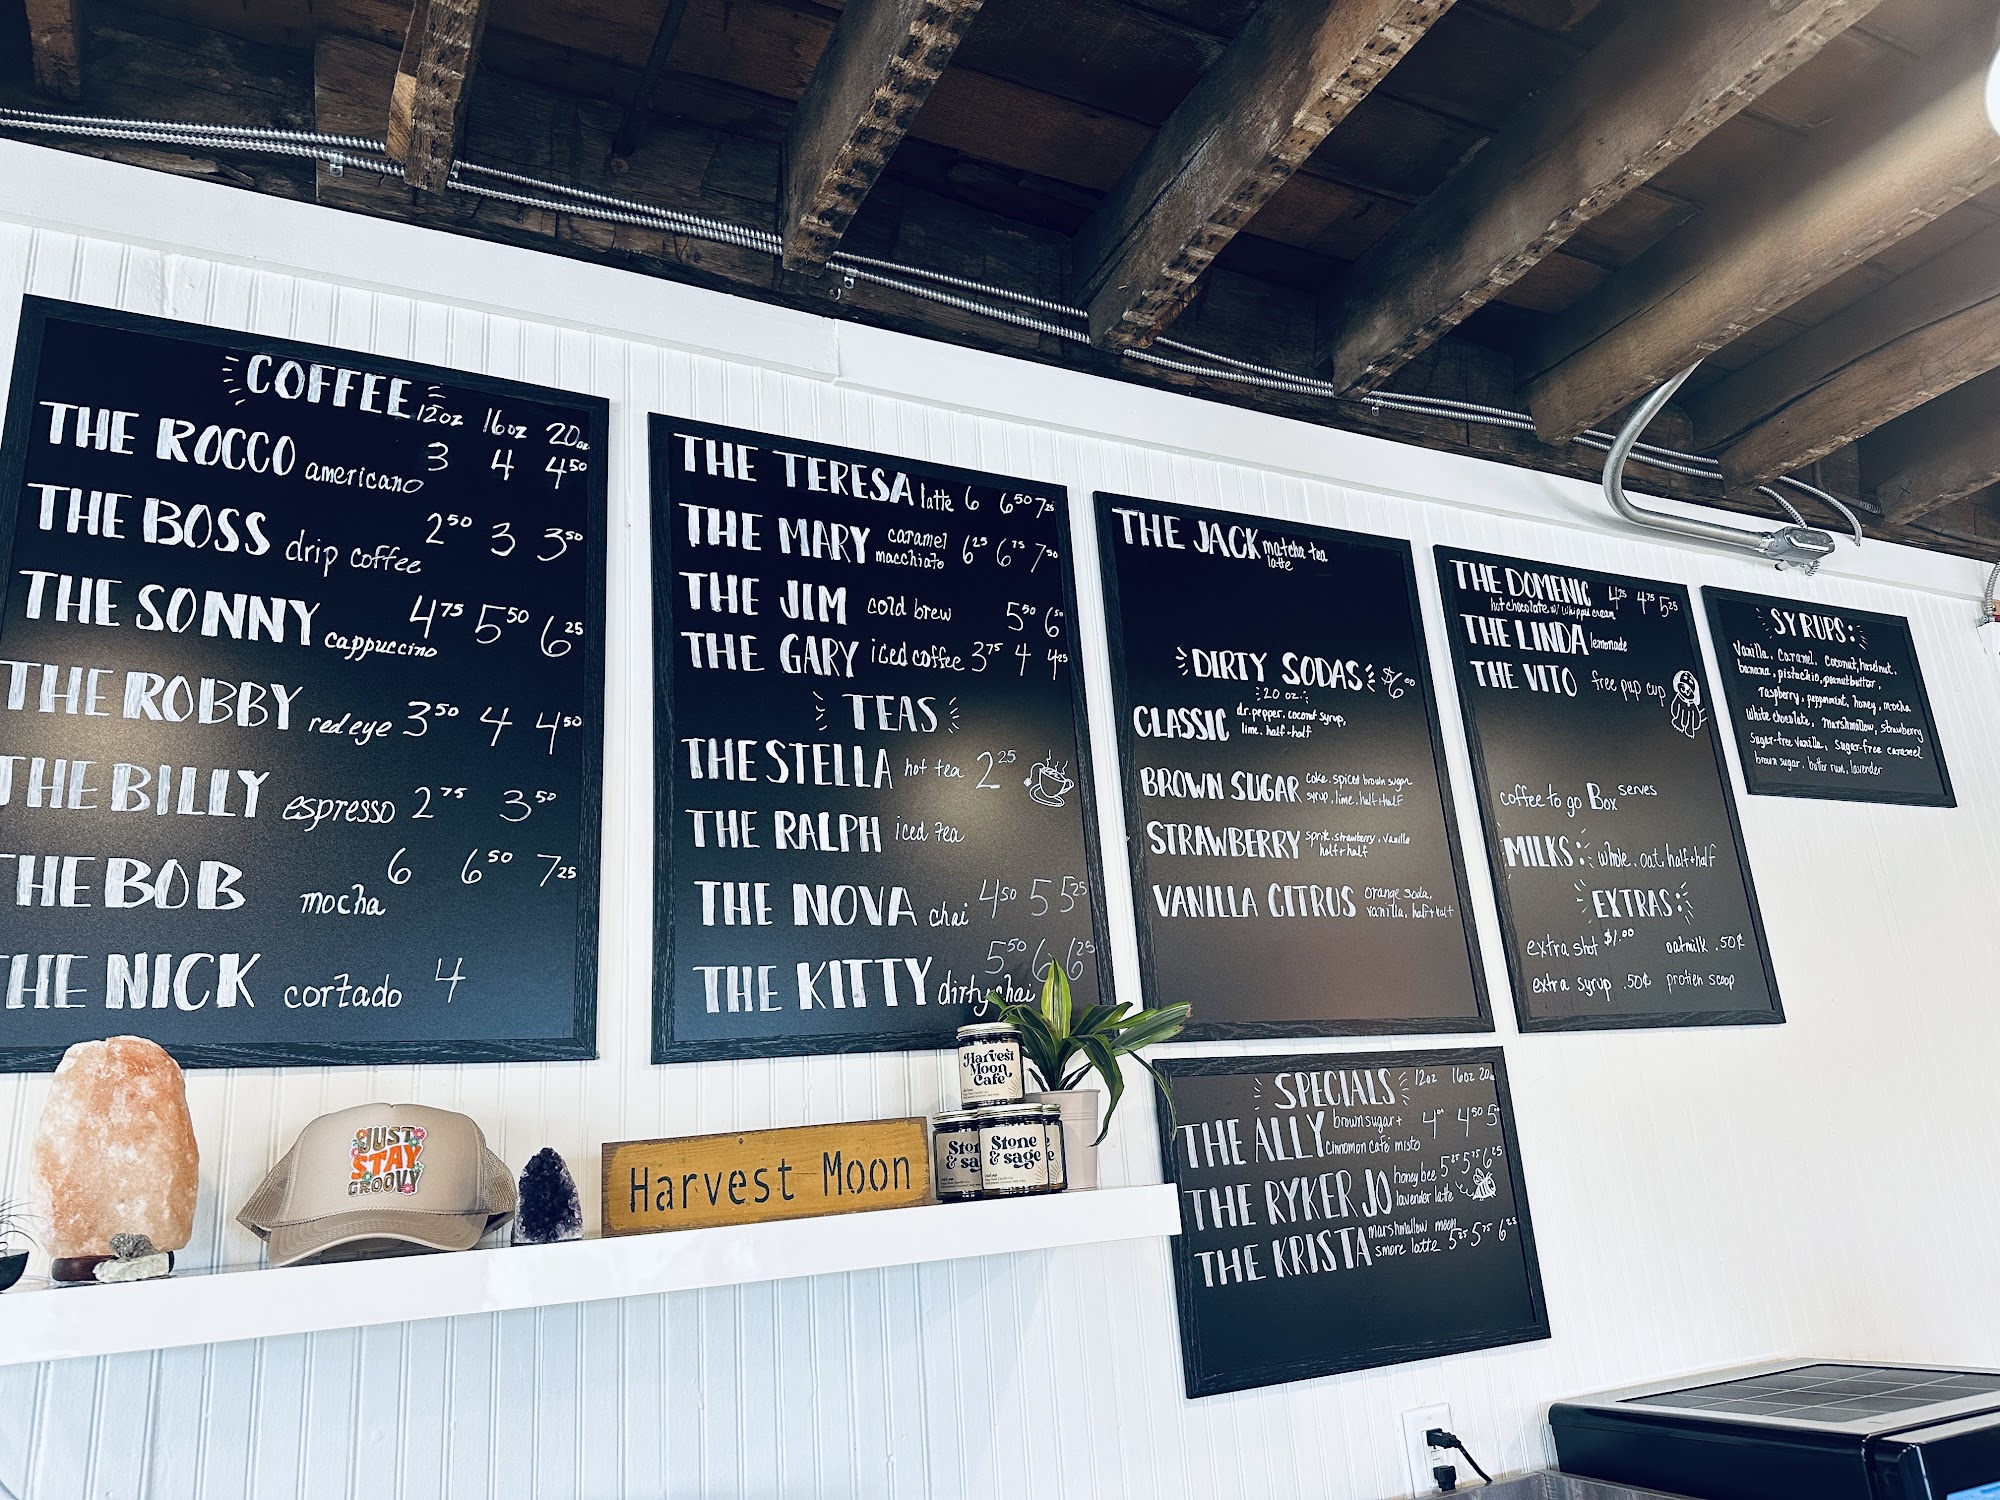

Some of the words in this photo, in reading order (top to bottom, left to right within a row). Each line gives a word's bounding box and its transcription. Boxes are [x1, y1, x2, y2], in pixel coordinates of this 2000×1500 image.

[247, 356, 412, 419] COFFEE
[417, 403, 463, 427] 12oz
[483, 408, 527, 439] 16oz
[40, 401, 139, 455] THE
[156, 418, 295, 476] ROCCO
[306, 461, 424, 494] americano
[426, 443, 448, 471] 3
[491, 449, 514, 480] 4
[674, 433, 758, 482] THE
[773, 451, 914, 504] TERESA
[921, 483, 954, 512] latte
[965, 487, 979, 510] 6
[28, 483, 132, 539] THE
[143, 498, 270, 557] BOSS
[286, 530, 338, 576] drip
[350, 545, 421, 574] coffee
[491, 523, 515, 557] 3
[679, 503, 762, 551] THE
[779, 517, 870, 563] MARY
[888, 527, 947, 549] caramel
[1112, 508, 1185, 549] THE
[1193, 520, 1261, 559] JACK
[1263, 540, 1306, 558] matcha
[1308, 542, 1328, 562] tea
[876, 551, 945, 570] macchiato
[1268, 557, 1293, 571] latte
[679, 572, 760, 616] THE
[780, 580, 847, 625] JIM
[868, 596, 906, 617] cold
[915, 603, 951, 621] brew
[1449, 560, 1502, 594] THE
[1505, 567, 1592, 606] DOMENIC
[19, 571, 122, 627] THE
[136, 585, 320, 647] SONNY
[324, 631, 437, 661] cappuccino
[1506, 598, 1550, 614] chocolate
[681, 631, 764, 672] THE
[780, 634, 859, 677] GARY
[871, 639, 907, 666] iced
[912, 647, 965, 672] coffee
[1015, 643, 1031, 676] 4
[1460, 614, 1512, 648] THE
[1514, 620, 1589, 656] LINDA
[1590, 632, 1628, 652] lemonade
[1192, 649, 1267, 681] DIRTY
[1282, 652, 1363, 690] SODAS
[1470, 661, 1519, 689] THE
[1522, 663, 1577, 697] VITO
[1591, 671, 1617, 692] free
[1621, 679, 1641, 701] pup
[1647, 682, 1666, 707] cup
[0, 660, 114, 716] THE
[123, 671, 303, 731] ROBBY
[480, 707, 512, 747] 4
[842, 693, 938, 733] TEAS
[1264, 687, 1280, 699] 20
[1134, 705, 1229, 741] CLASSIC
[681, 738, 757, 781] THE
[765, 739, 893, 790] STELLA
[905, 758, 927, 777] hot
[935, 759, 964, 779] tea
[0, 755, 99, 809] THE
[111, 763, 269, 819] BILLY
[282, 794, 395, 831] espresso
[1140, 767, 1224, 800] BROWN
[1231, 771, 1302, 803] SUGAR
[1333, 774, 1359, 789] spiced
[1500, 784, 1545, 806] coffee
[1547, 784, 1561, 808] to
[1567, 798, 1582, 817] go
[1587, 783, 1617, 811] Box
[1618, 784, 1657, 796] serves
[685, 809, 760, 848] THE
[775, 810, 881, 852] RALPH
[896, 816, 928, 842] iced
[935, 822, 965, 843] tea
[1146, 821, 1300, 859] STRAWBERRY
[0, 853, 95, 907] HE
[105, 858, 246, 911] BOB
[300, 885, 385, 917] mocha
[387, 848, 412, 885] 6
[694, 881, 772, 926] THE
[792, 884, 917, 926] NOVA
[929, 903, 969, 927] chai
[1030, 879, 1051, 916] 5
[1153, 885, 1258, 917] VANILLA
[1268, 883, 1356, 918] CITRUS
[1365, 887, 1401, 904] orange
[1527, 934, 1569, 956] extra
[1573, 936, 1598, 956] shot
[1666, 936, 1708, 954] oatmilk
[0, 953, 88, 1010] HE
[105, 952, 262, 1011] NICK
[284, 974, 402, 1007] cortado
[435, 958, 466, 1003] 4
[693, 965, 782, 1013] THE
[796, 957, 932, 1010] KITTY
[1533, 973, 1570, 993] extra
[1578, 975, 1611, 1001] syrup
[1709, 973, 1734, 990] scoop
[964, 1049, 1014, 1067] Harvest
[971, 1064, 1012, 1077] Moon
[974, 1072, 1005, 1085] Cafe
[1274, 1068, 1396, 1109] SPECIALS
[1415, 1069, 1437, 1086] 12oz
[360, 1126, 416, 1152] JUST
[990, 1152, 1001, 1165] &
[1004, 1150, 1041, 1169] sage
[991, 1135, 1037, 1150] Stone
[1177, 1119, 1247, 1169] THE
[1255, 1111, 1324, 1162] ALLY
[1395, 1136, 1420, 1152] misto
[352, 1144, 423, 1180] STAY
[630, 1157, 794, 1213] Harvest
[822, 1151, 911, 1197] Moon
[961, 1158, 981, 1172] sa
[348, 1170, 420, 1196] GROOVY
[1185, 1184, 1257, 1231] THE
[1265, 1169, 1359, 1225] RYKER
[1362, 1168, 1392, 1218] JO
[1393, 1165, 1419, 1188] honey
[1420, 1162, 1436, 1182] bee
[1396, 1190, 1430, 1206] lavender
[1434, 1184, 1454, 1202] latte
[1194, 1244, 1266, 1288] THE
[1273, 1226, 1373, 1279] KRISTA
[1368, 1217, 1427, 1239] marshmallow
[1375, 1244, 1406, 1257] smore
[1412, 1238, 1441, 1252] latte
